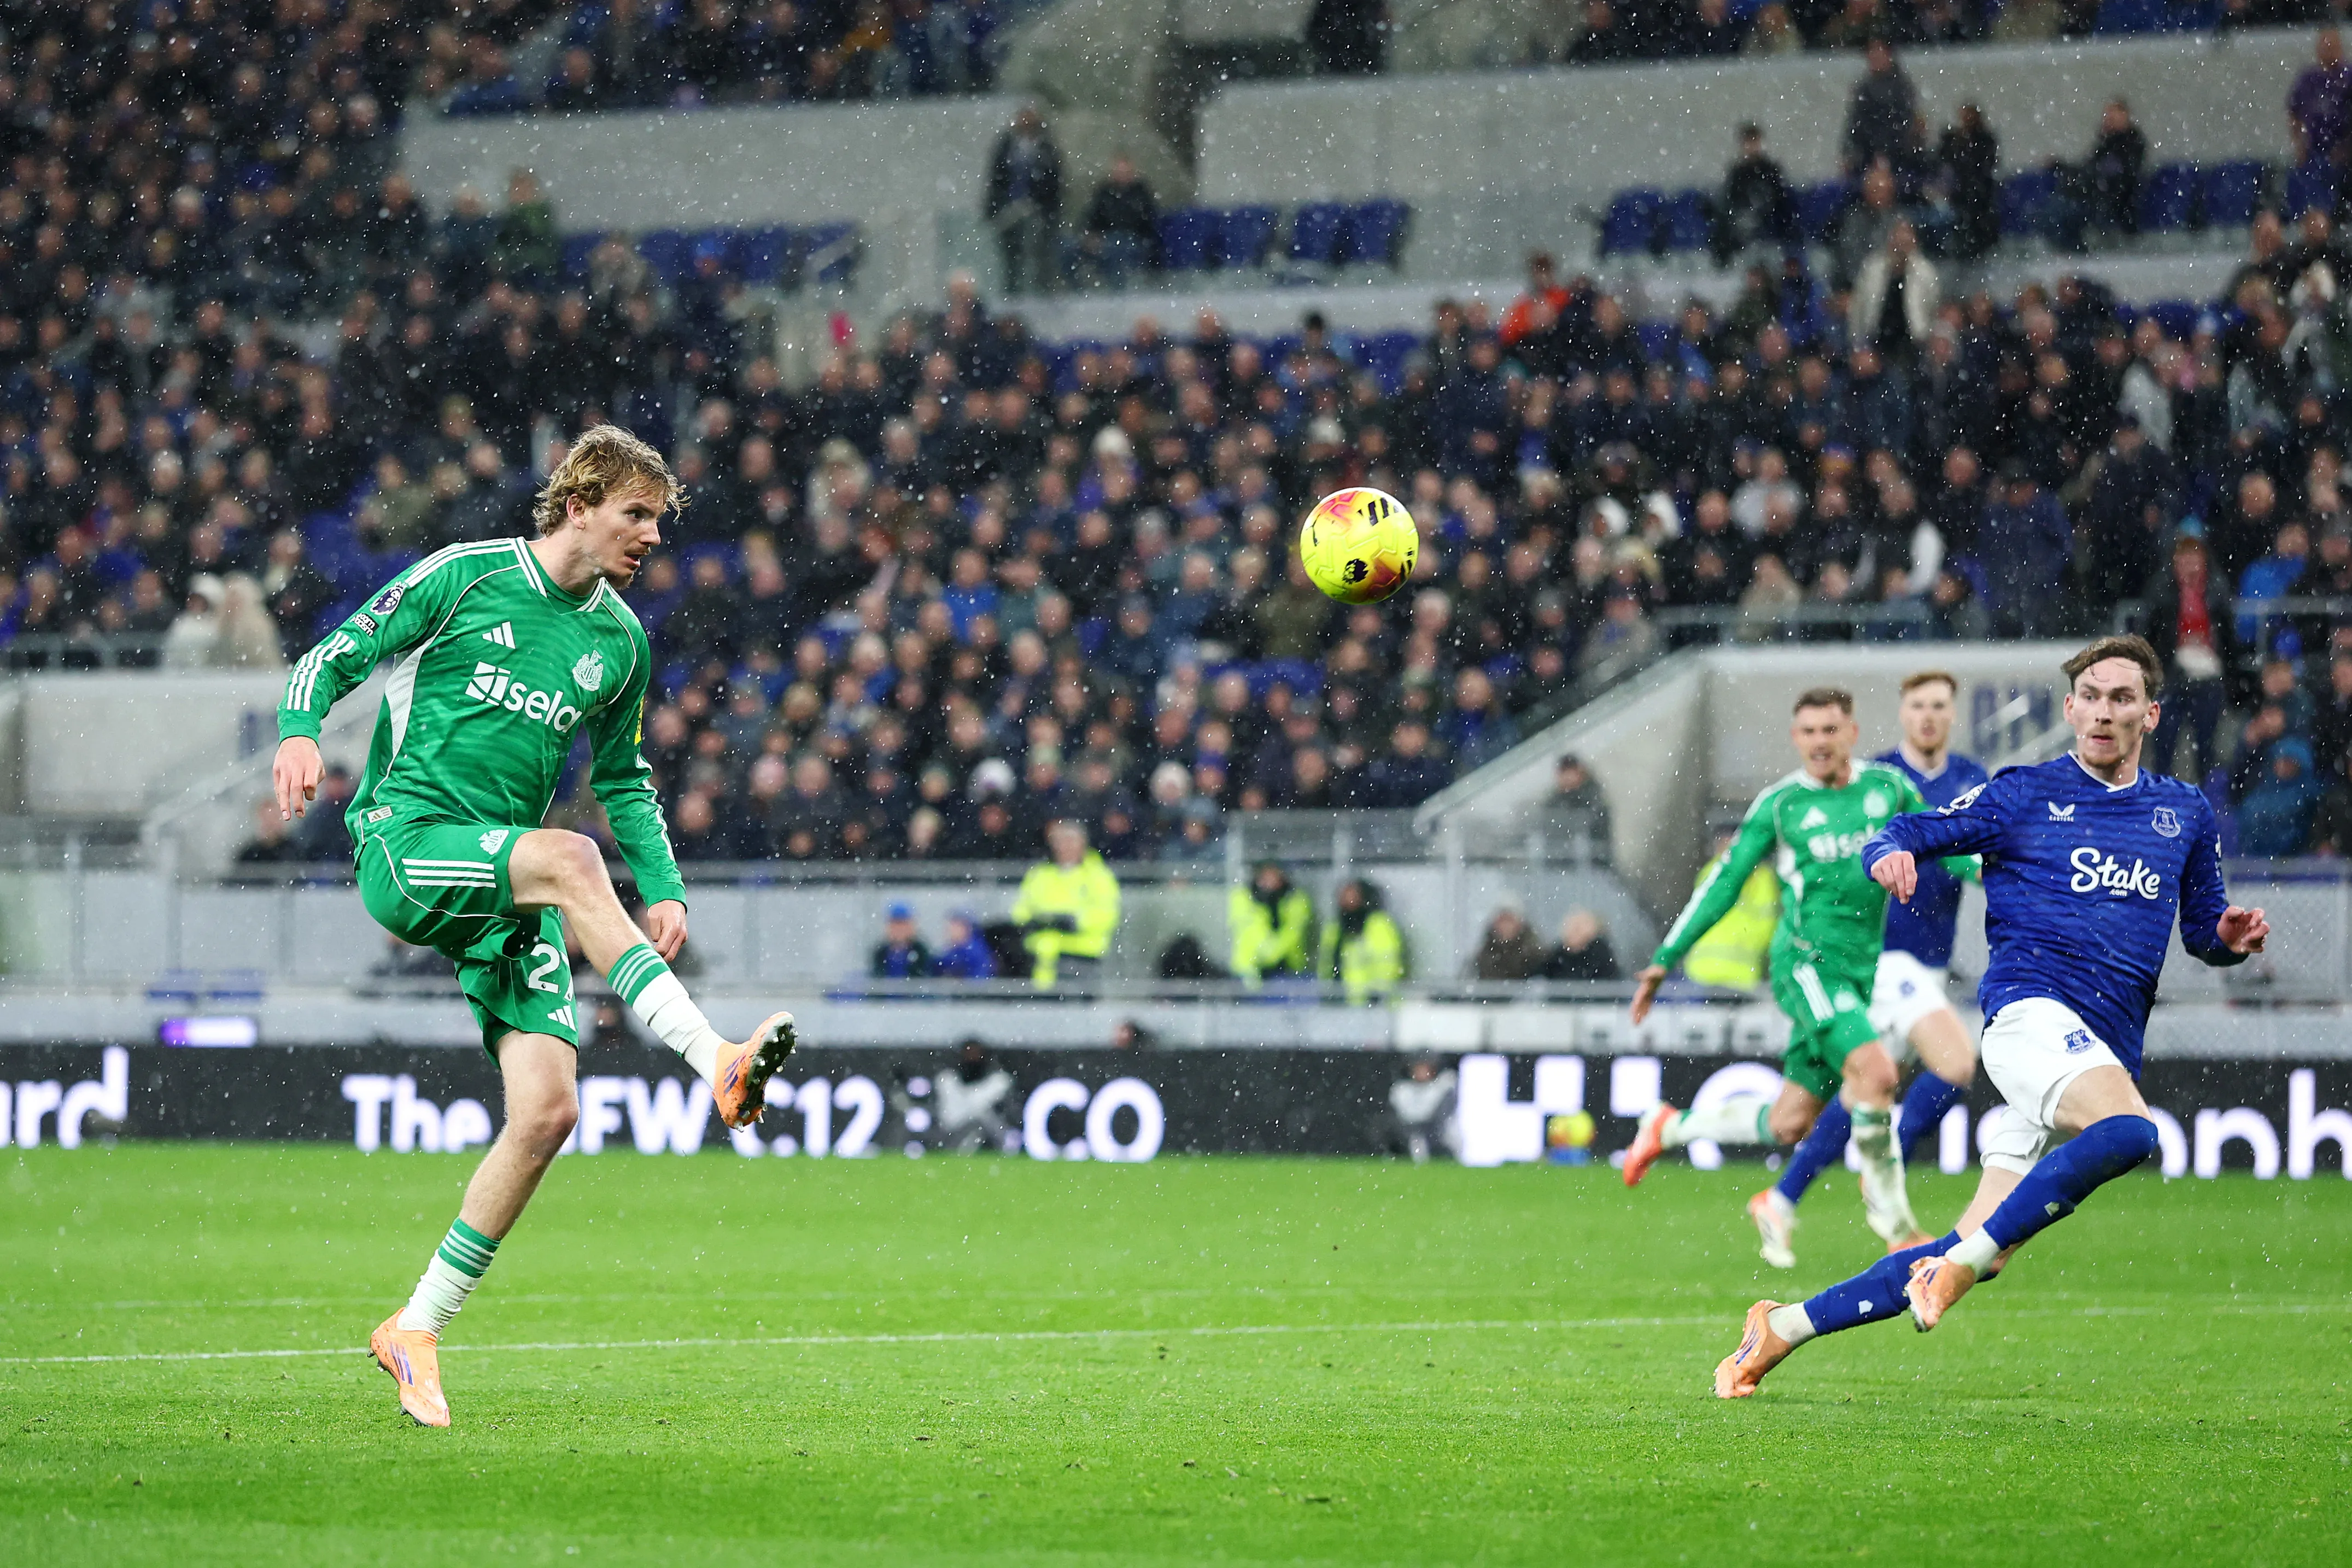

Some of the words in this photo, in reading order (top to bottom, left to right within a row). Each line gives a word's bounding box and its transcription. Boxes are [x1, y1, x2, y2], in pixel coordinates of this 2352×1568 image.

[504, 682, 582, 733] sela
[2070, 846, 2161, 900] Stake
[341, 1073, 492, 1155] The
